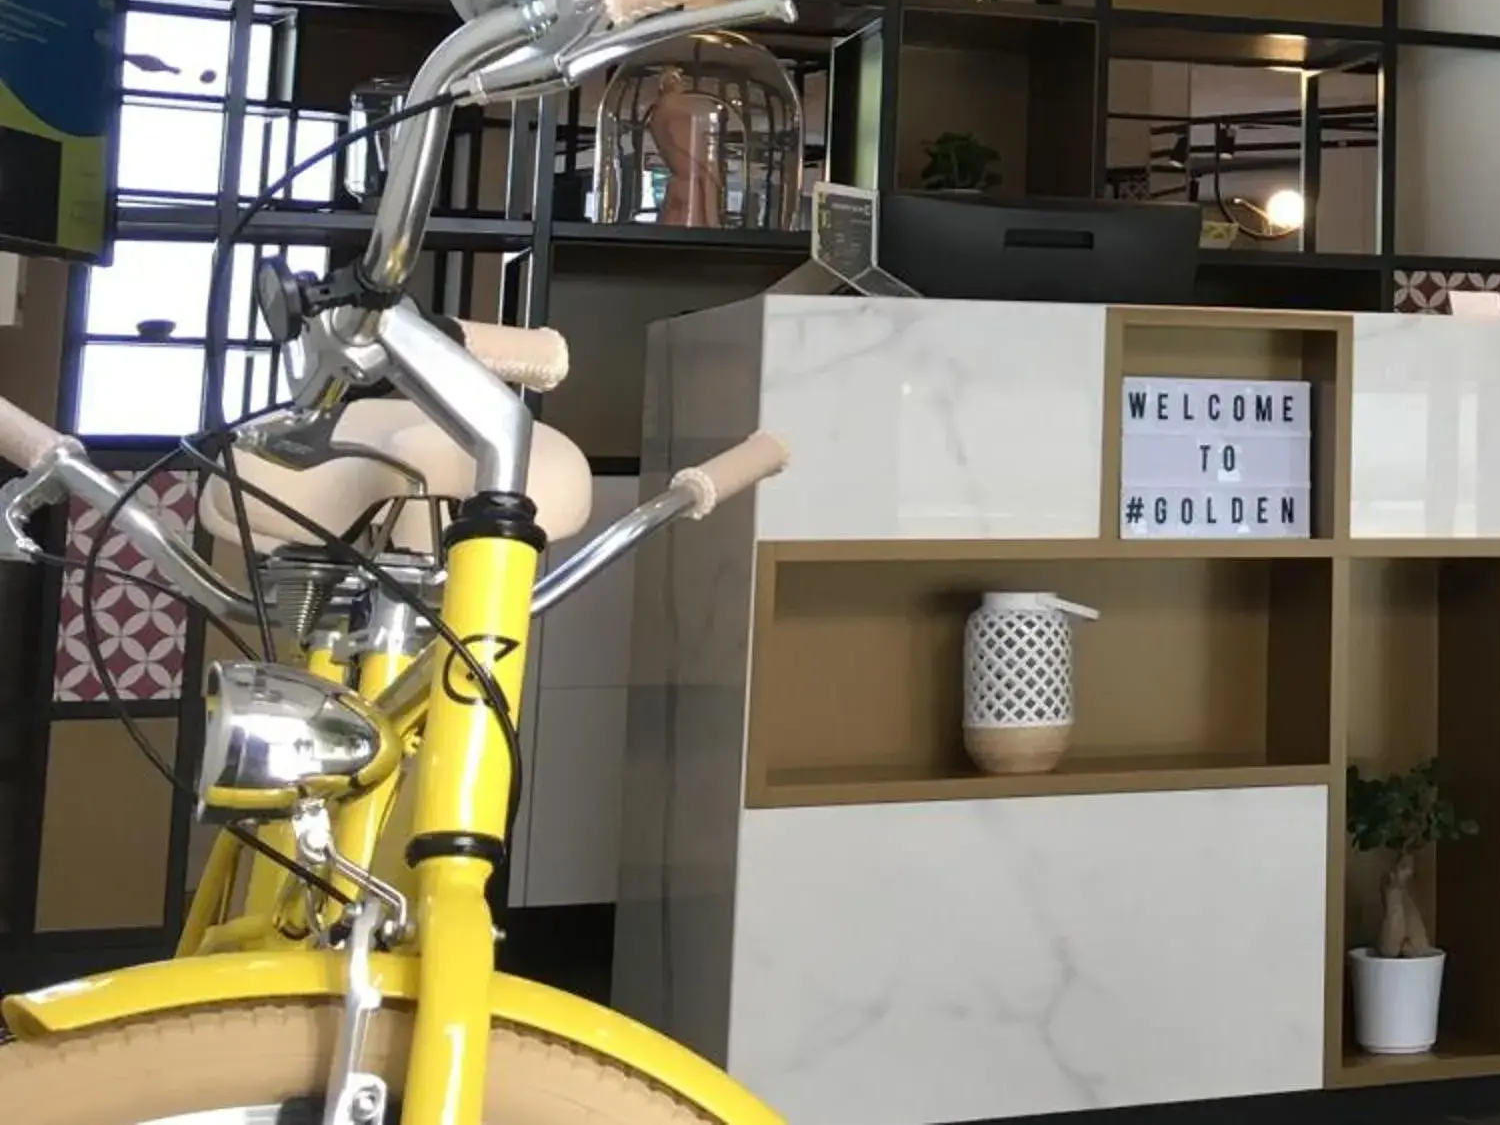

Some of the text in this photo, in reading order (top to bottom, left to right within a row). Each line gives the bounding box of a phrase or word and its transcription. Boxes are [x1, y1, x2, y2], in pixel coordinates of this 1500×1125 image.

[1128, 392, 1294, 422] WELCOME
[1199, 445, 1236, 472] TO
[1125, 496, 1296, 524] #GOLDEN
